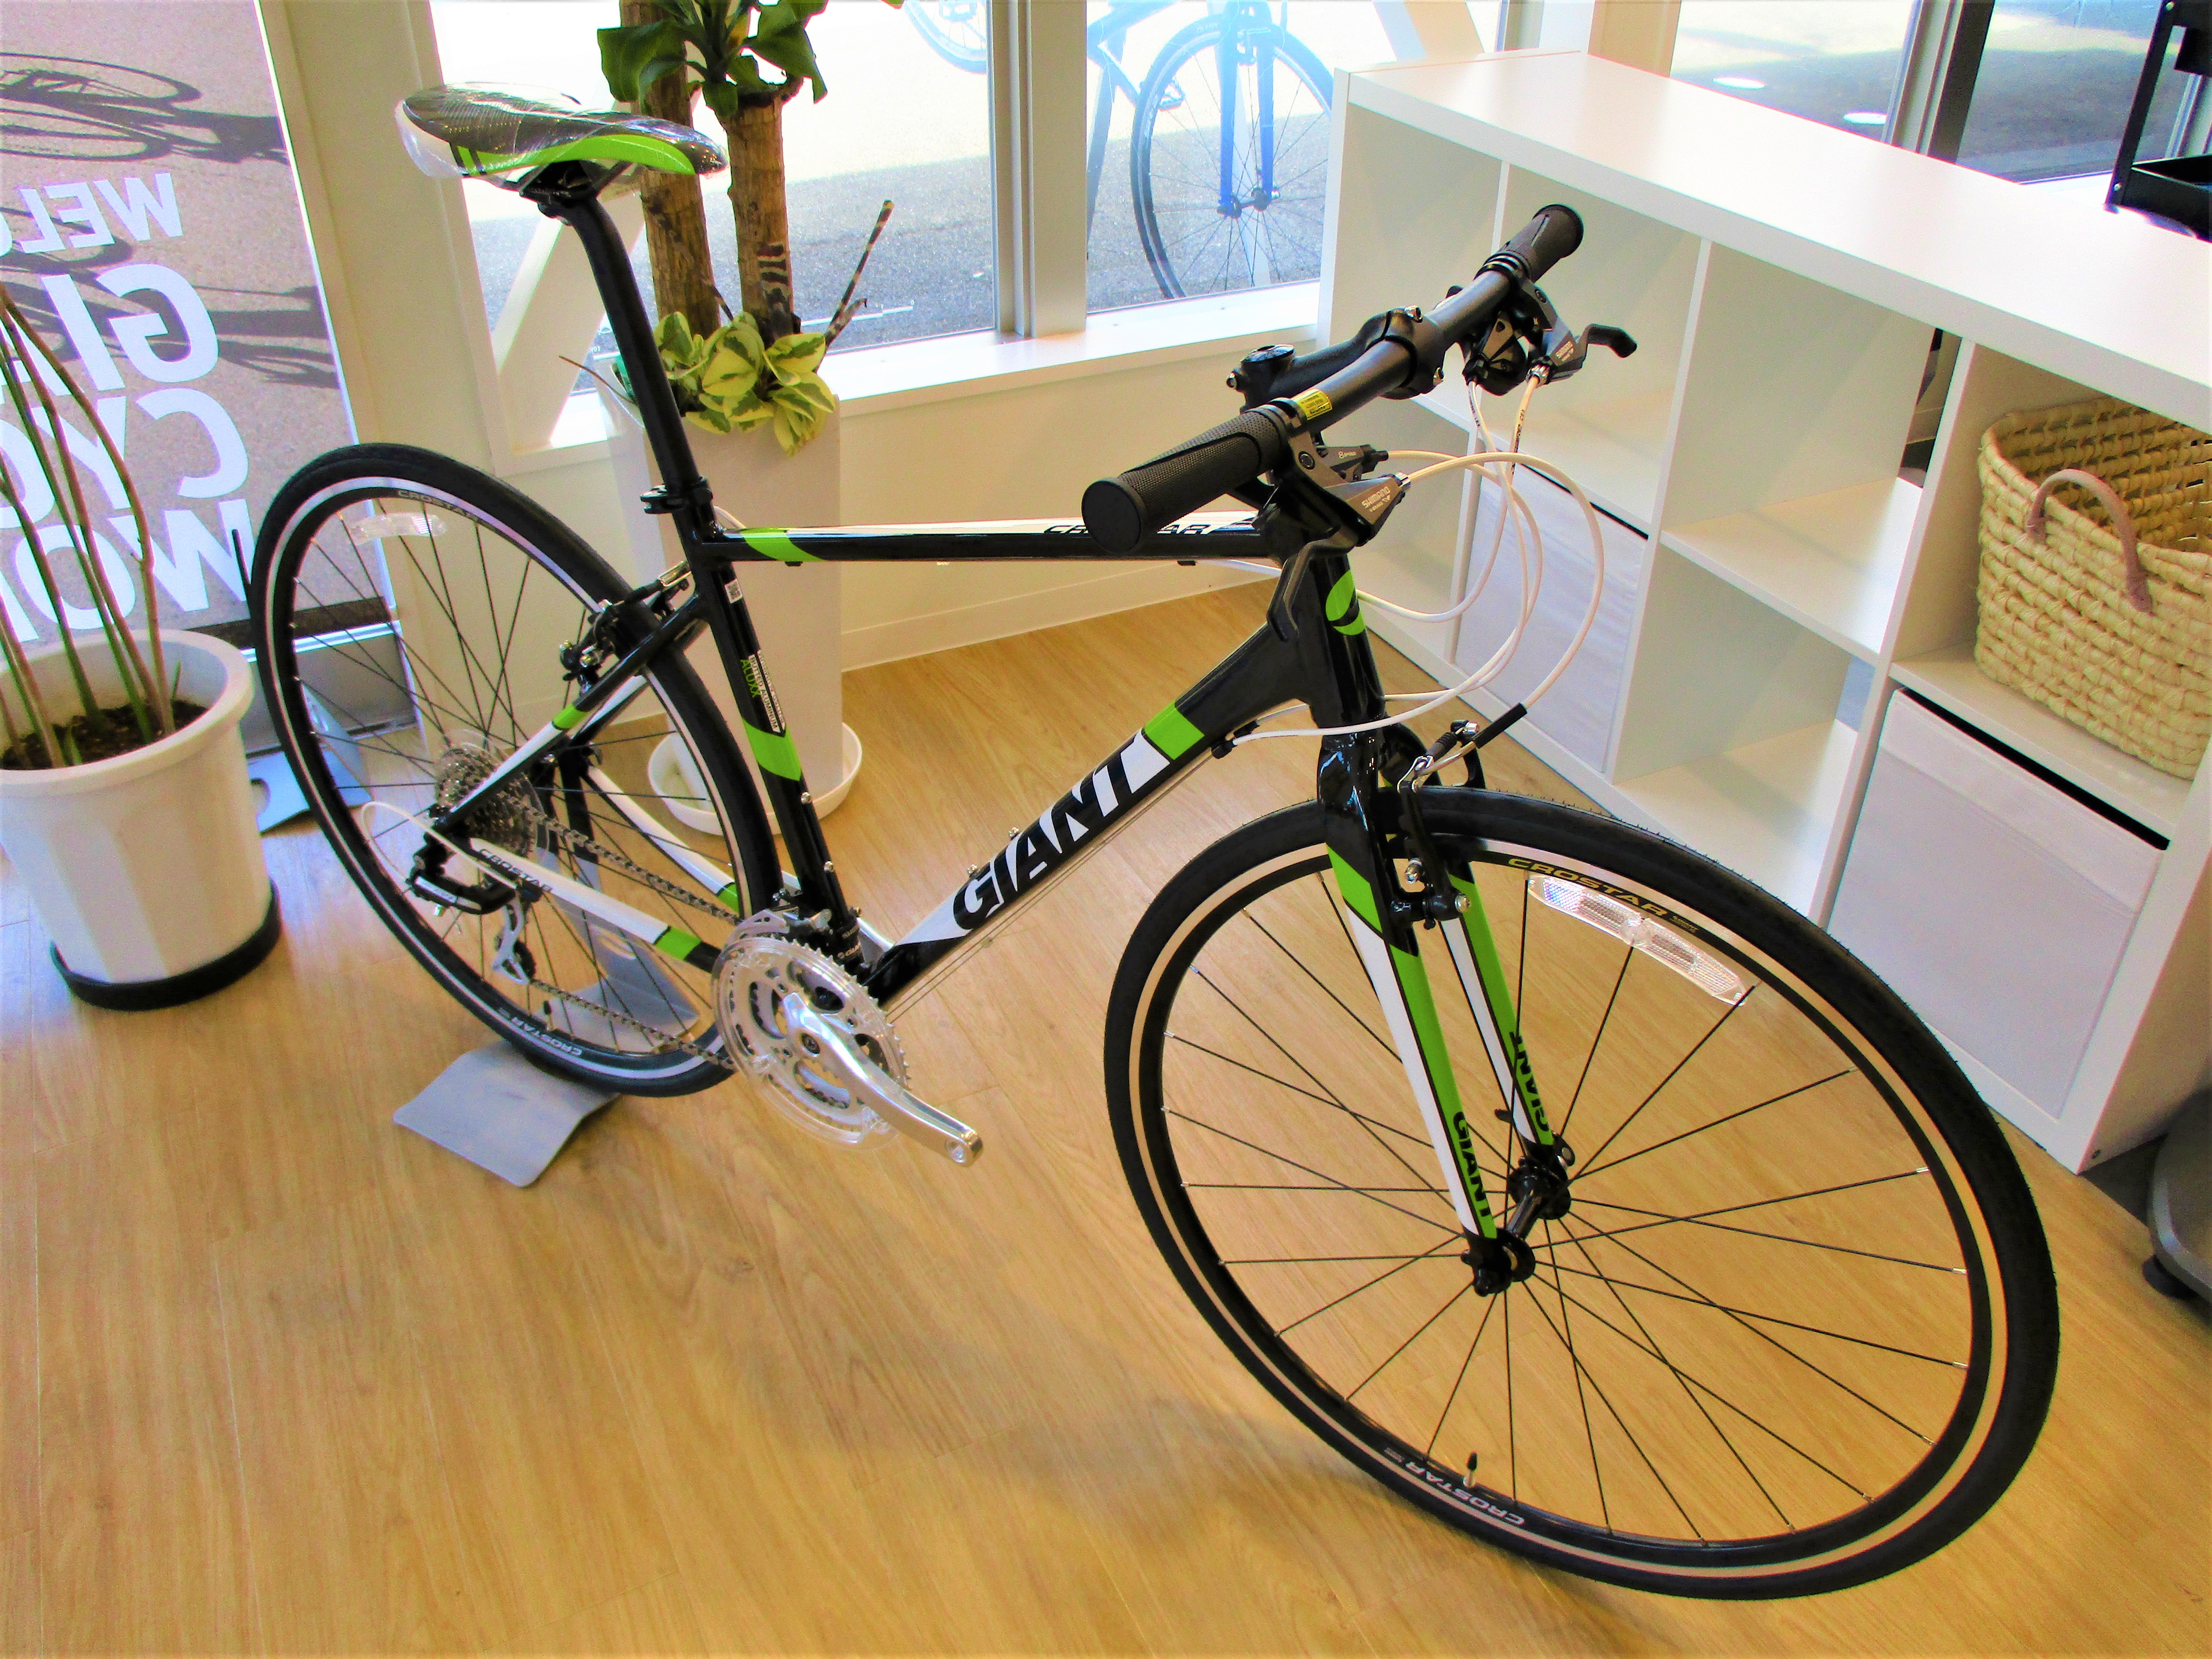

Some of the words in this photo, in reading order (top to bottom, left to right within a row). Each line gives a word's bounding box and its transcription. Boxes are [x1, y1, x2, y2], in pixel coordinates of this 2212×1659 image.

[1361, 486, 1391, 509] SHIMANO
[740, 659, 761, 698] ALUXX
[750, 656, 763, 687] BUTTED
[760, 689, 778, 729] ALUMINUM
[953, 735, 1142, 930] GIANT
[479, 848, 553, 893] CROSTAR
[1508, 858, 1668, 917] CROSTAR
[511, 1016, 583, 1056] CROSTAR
[1509, 1031, 1550, 1132] GIANT
[1453, 1112, 1491, 1216] GIANT
[1405, 1461, 1525, 1525] CROSTAR
